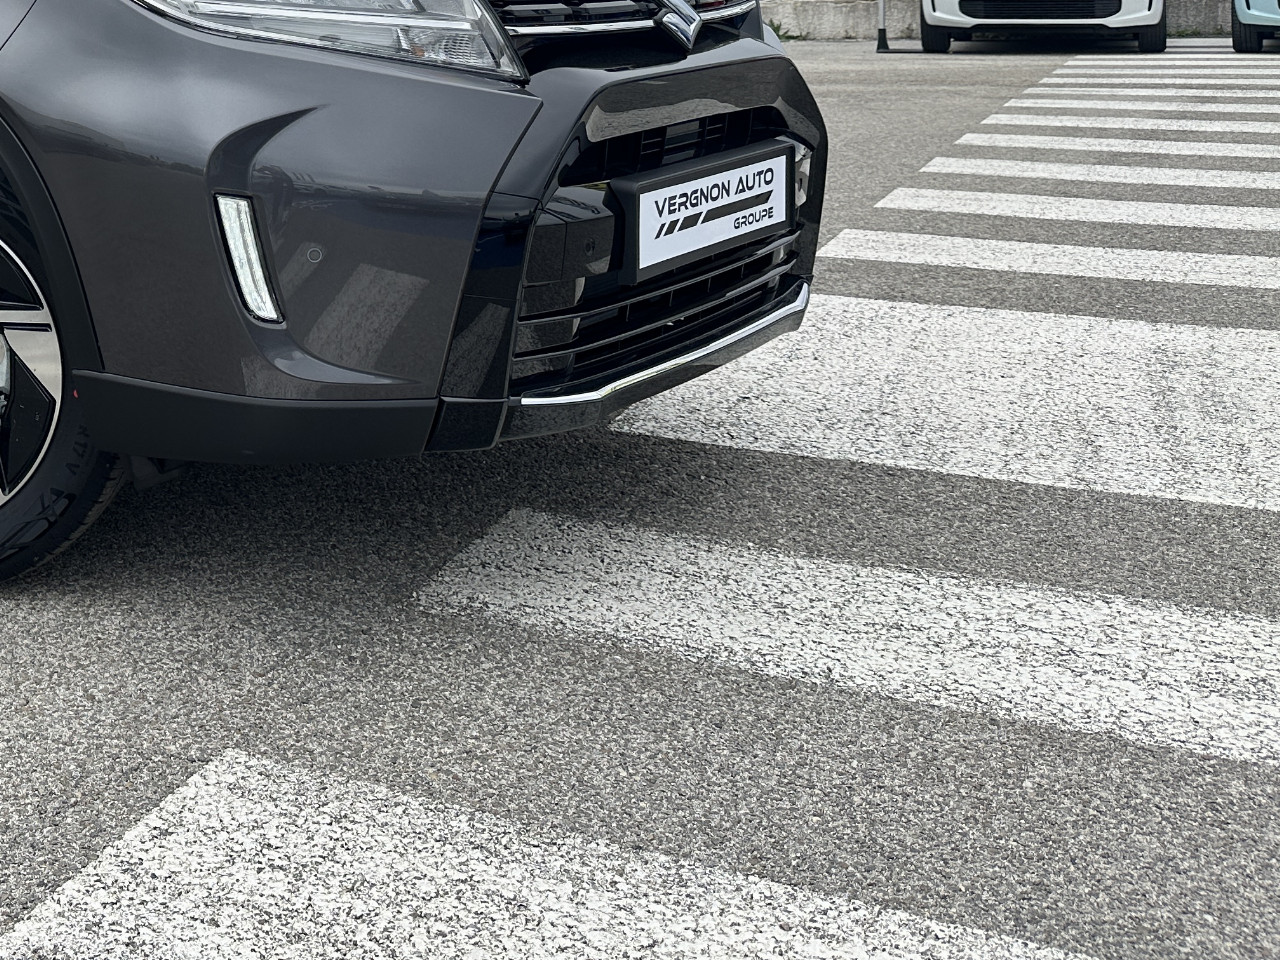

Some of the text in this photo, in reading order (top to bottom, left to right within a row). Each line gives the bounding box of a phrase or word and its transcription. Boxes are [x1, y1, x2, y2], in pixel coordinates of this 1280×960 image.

[654, 167, 775, 218] VERGNON AUTO
[733, 206, 774, 230] GROUPE
